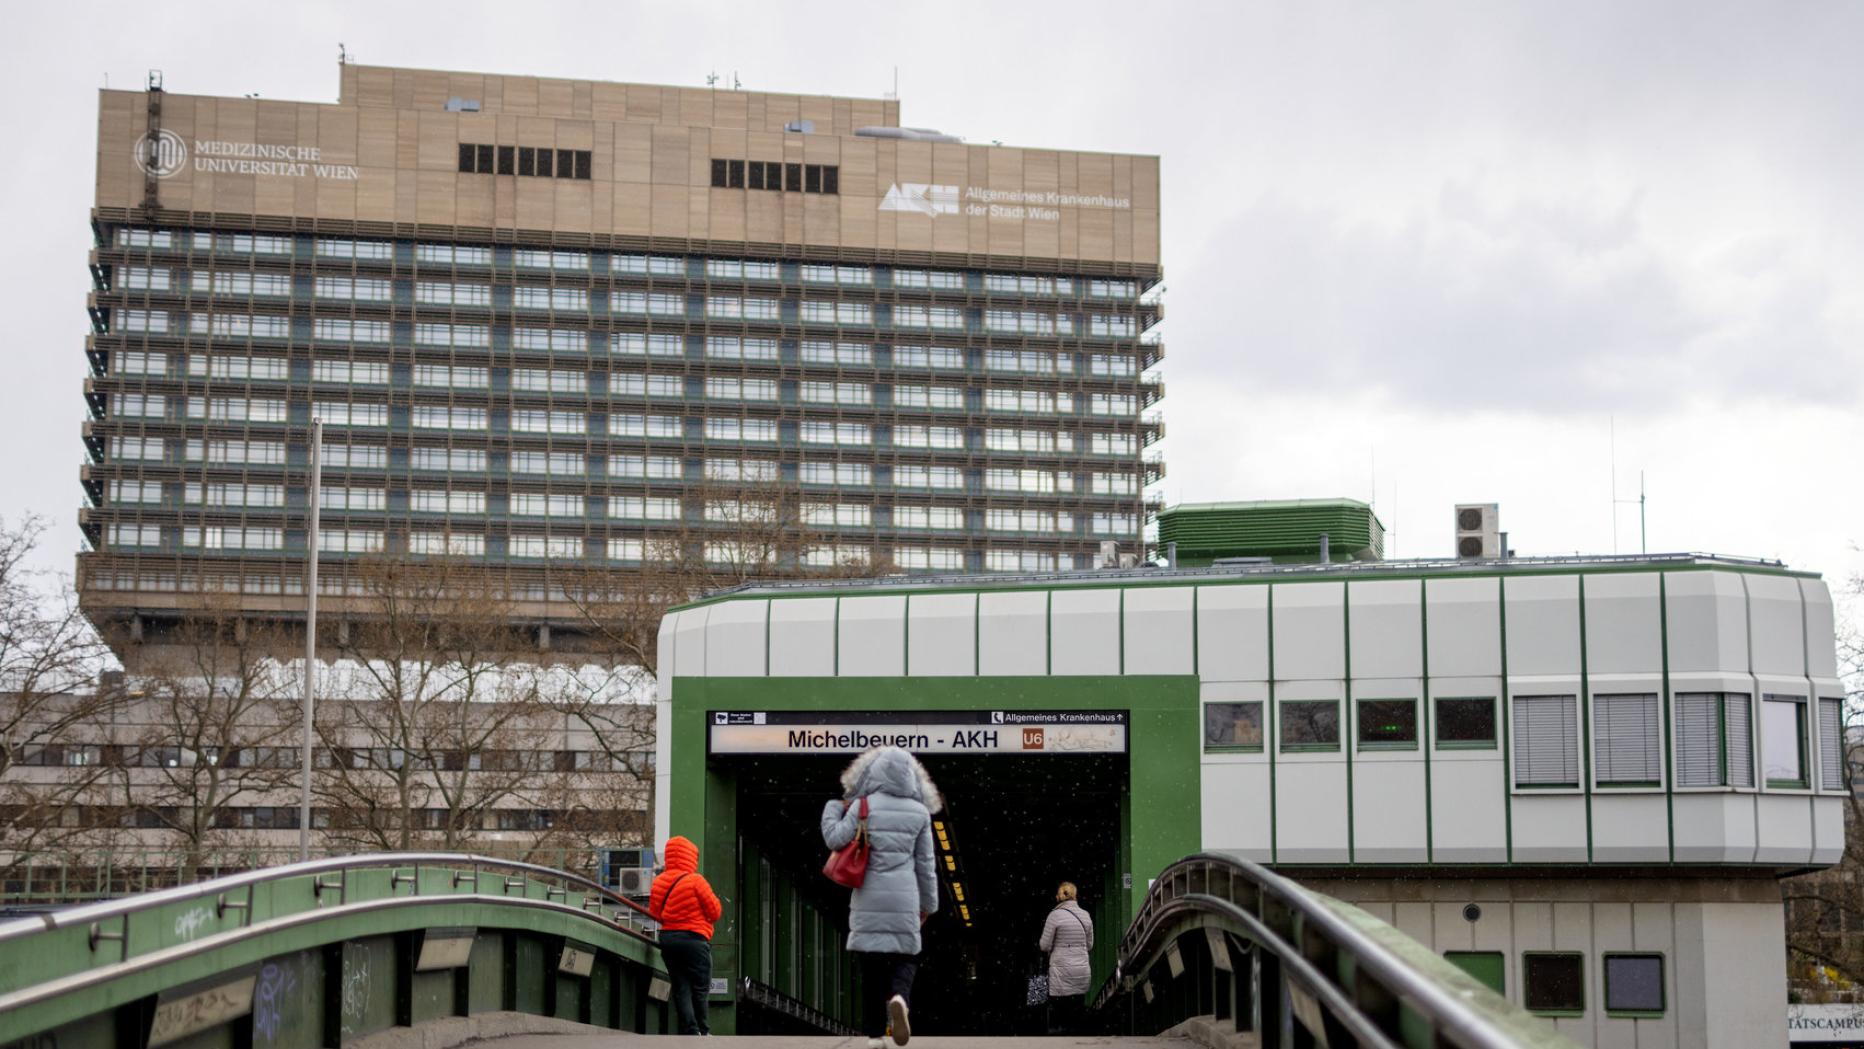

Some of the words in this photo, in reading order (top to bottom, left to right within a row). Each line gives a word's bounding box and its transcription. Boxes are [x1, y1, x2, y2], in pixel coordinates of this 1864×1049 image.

[194, 140, 321, 161] MEDIZINISCHE
[194, 157, 309, 177] UNIVERSITÄT
[312, 164, 360, 180] WIEN
[877, 183, 960, 217] AKH
[965, 186, 1045, 203] Allgemeines
[1046, 191, 1130, 209] Krankenhaus
[965, 203, 987, 216] der
[990, 204, 1025, 219] Stadt
[1028, 207, 1060, 221] Wien
[1005, 713, 1057, 723] Allgemeines
[1060, 713, 1116, 722] Krankenhaus
[788, 730, 929, 749] Michelbeuern
[952, 730, 998, 748] AKH
[1023, 732, 1043, 746] U6
[1786, 1016, 1864, 1030] TÄTSCAMPU
